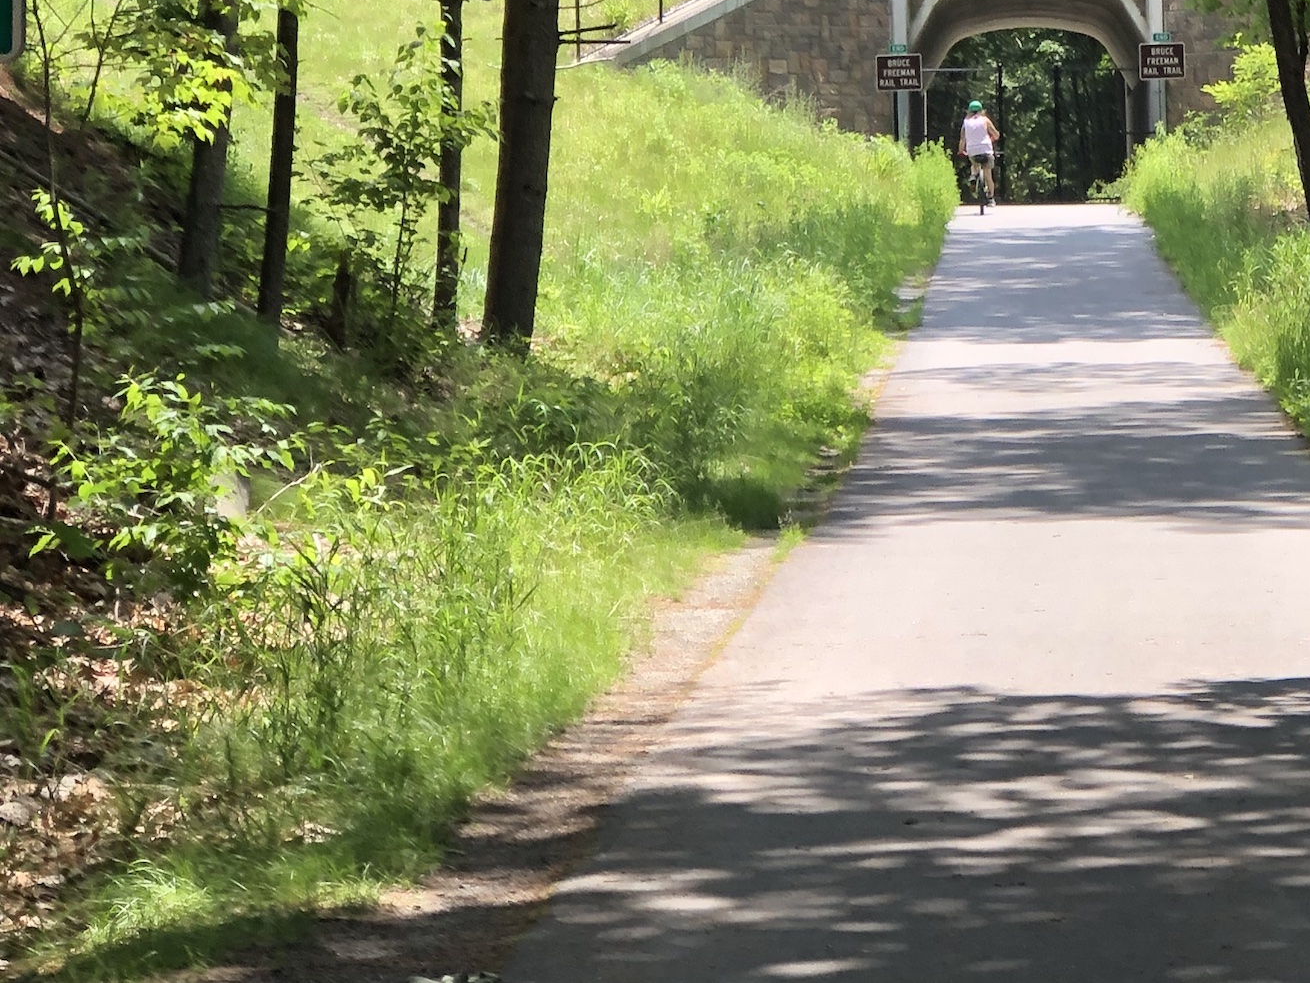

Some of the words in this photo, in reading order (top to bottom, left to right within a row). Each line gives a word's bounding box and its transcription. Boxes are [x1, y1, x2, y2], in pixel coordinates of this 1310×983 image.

[1151, 47, 1174, 55] BRUCE
[887, 59, 910, 67] BRUCE
[1146, 57, 1178, 65] FREEMAN
[883, 69, 915, 77] FREEMAN
[1143, 67, 1158, 75] RAIL
[900, 78, 919, 86] TRAIL
